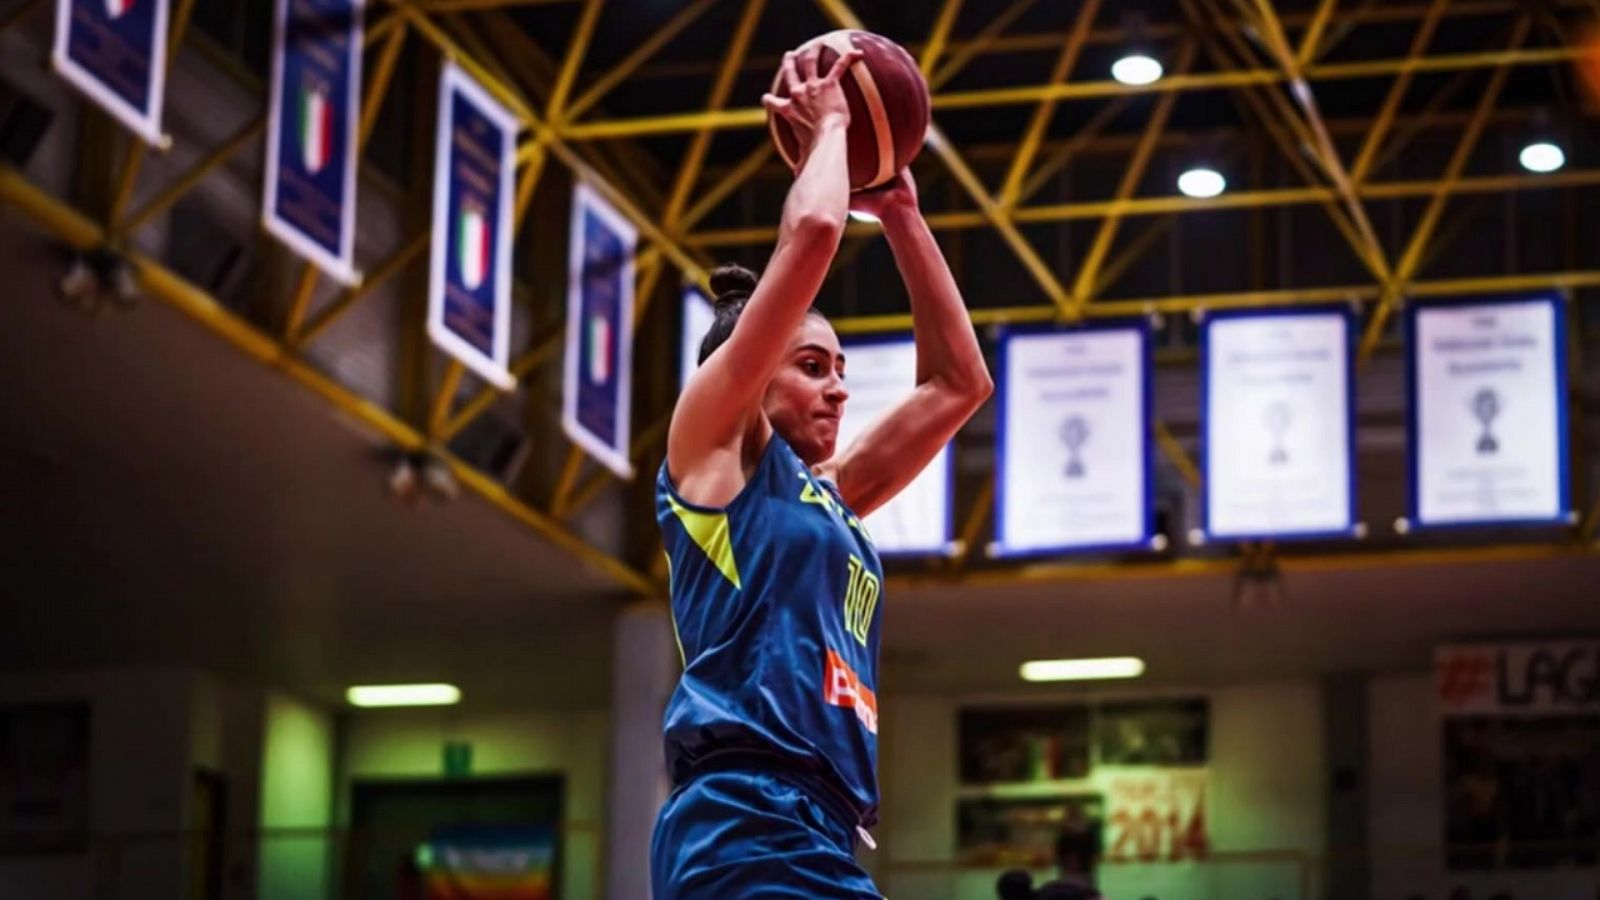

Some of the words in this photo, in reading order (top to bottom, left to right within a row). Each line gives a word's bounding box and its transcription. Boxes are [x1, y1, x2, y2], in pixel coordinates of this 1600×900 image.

[844, 553, 880, 647] 10
[1440, 647, 1600, 706] #LAG
[1108, 803, 1209, 863] 2014
